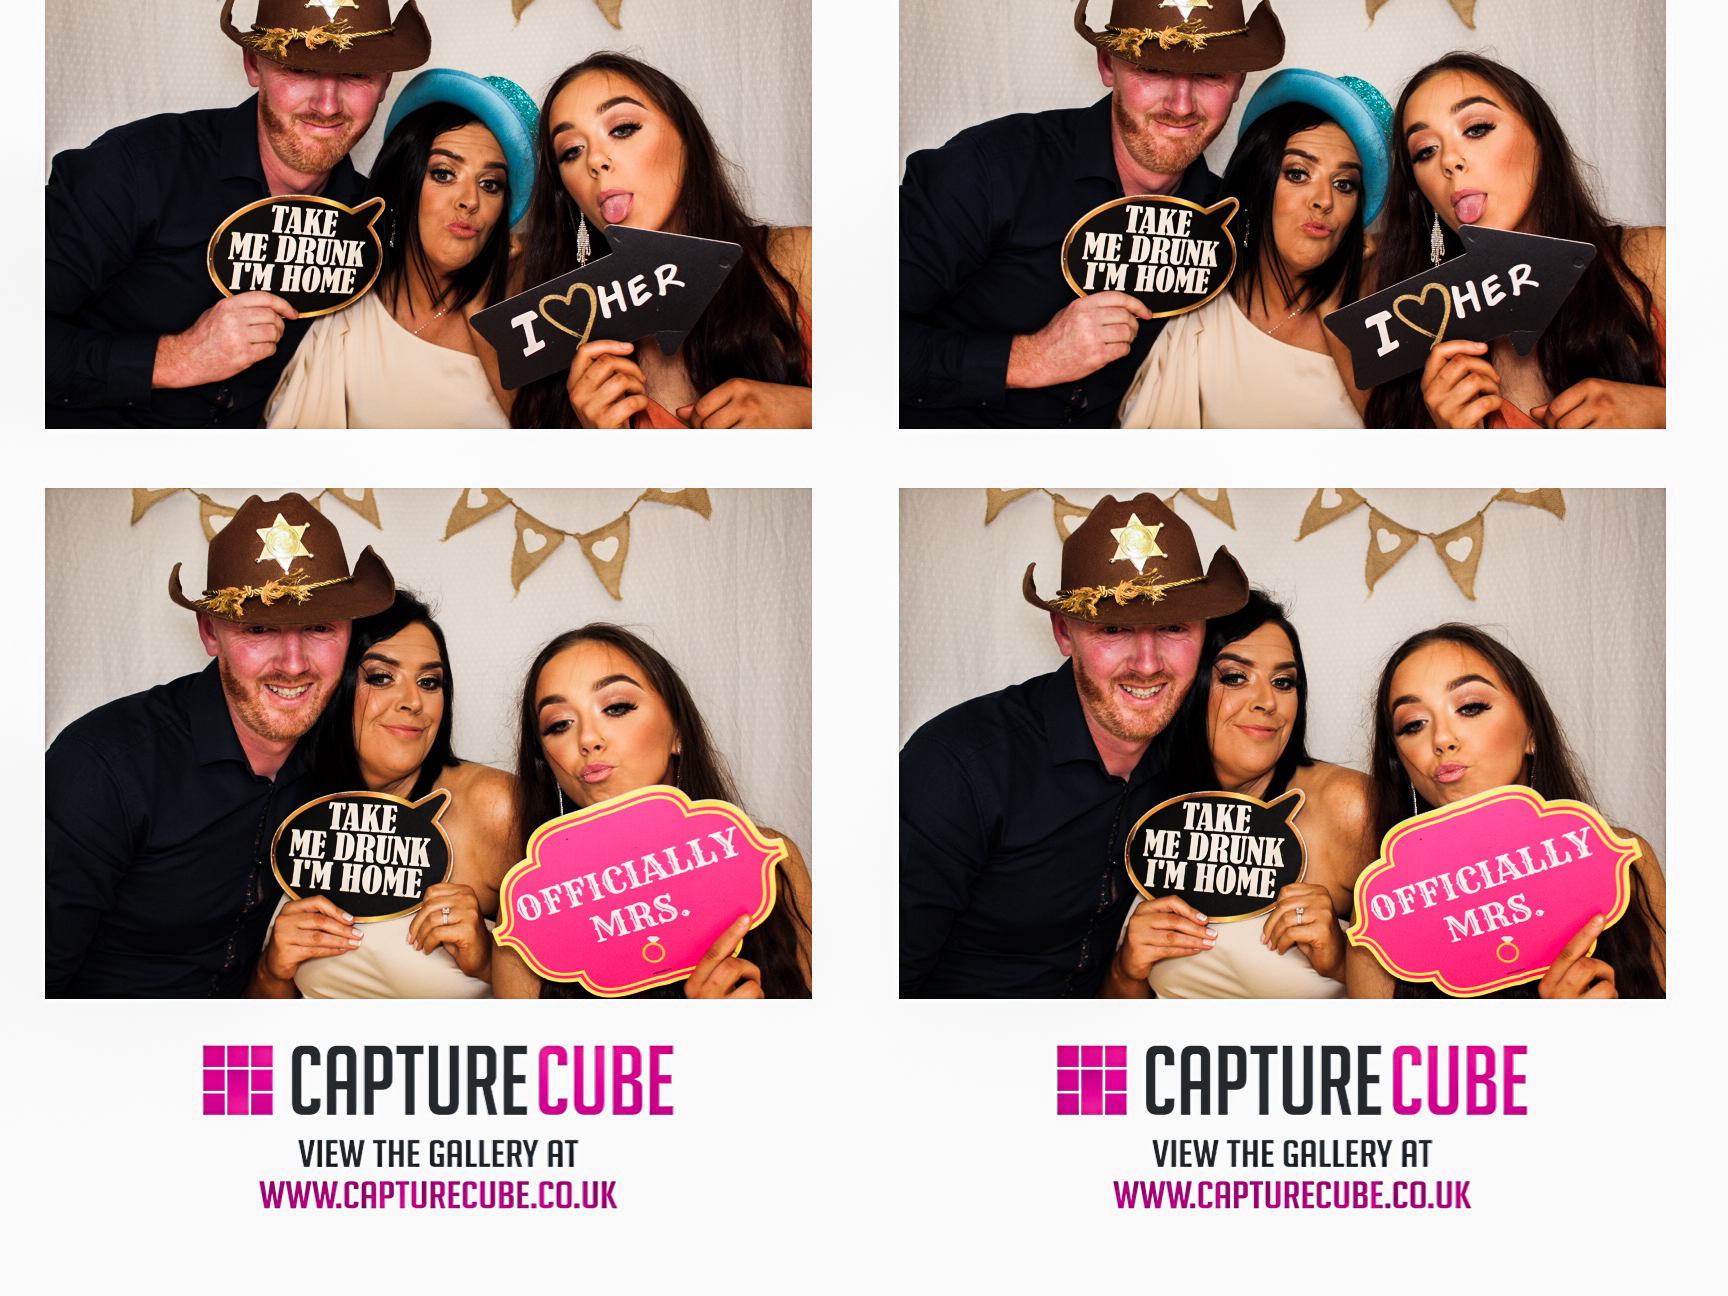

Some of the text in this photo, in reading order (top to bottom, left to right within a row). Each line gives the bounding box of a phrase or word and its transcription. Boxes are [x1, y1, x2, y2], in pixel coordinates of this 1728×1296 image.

[271, 204, 339, 237] TAKE
[1125, 204, 1193, 237] TAKE
[227, 231, 366, 267] ME DRUNK
[1081, 231, 1220, 267] ME DRUNK
[228, 261, 357, 294] I'M HOME
[1082, 261, 1211, 294] I'M HOME
[510, 263, 686, 357] I HER
[1364, 263, 1540, 357] I HER
[328, 801, 398, 834] TAKE
[1182, 801, 1252, 834] TAKE
[288, 828, 431, 867] ME DRUNK
[1142, 828, 1285, 867] ME DRUNK
[289, 858, 423, 899] I'M HOME
[516, 825, 739, 921] OFFICIALLY
[1143, 858, 1277, 899] I'M HOME
[1370, 825, 1593, 921] OFFICIALLY
[588, 892, 691, 943] MRS.
[1442, 892, 1545, 943] MRS.
